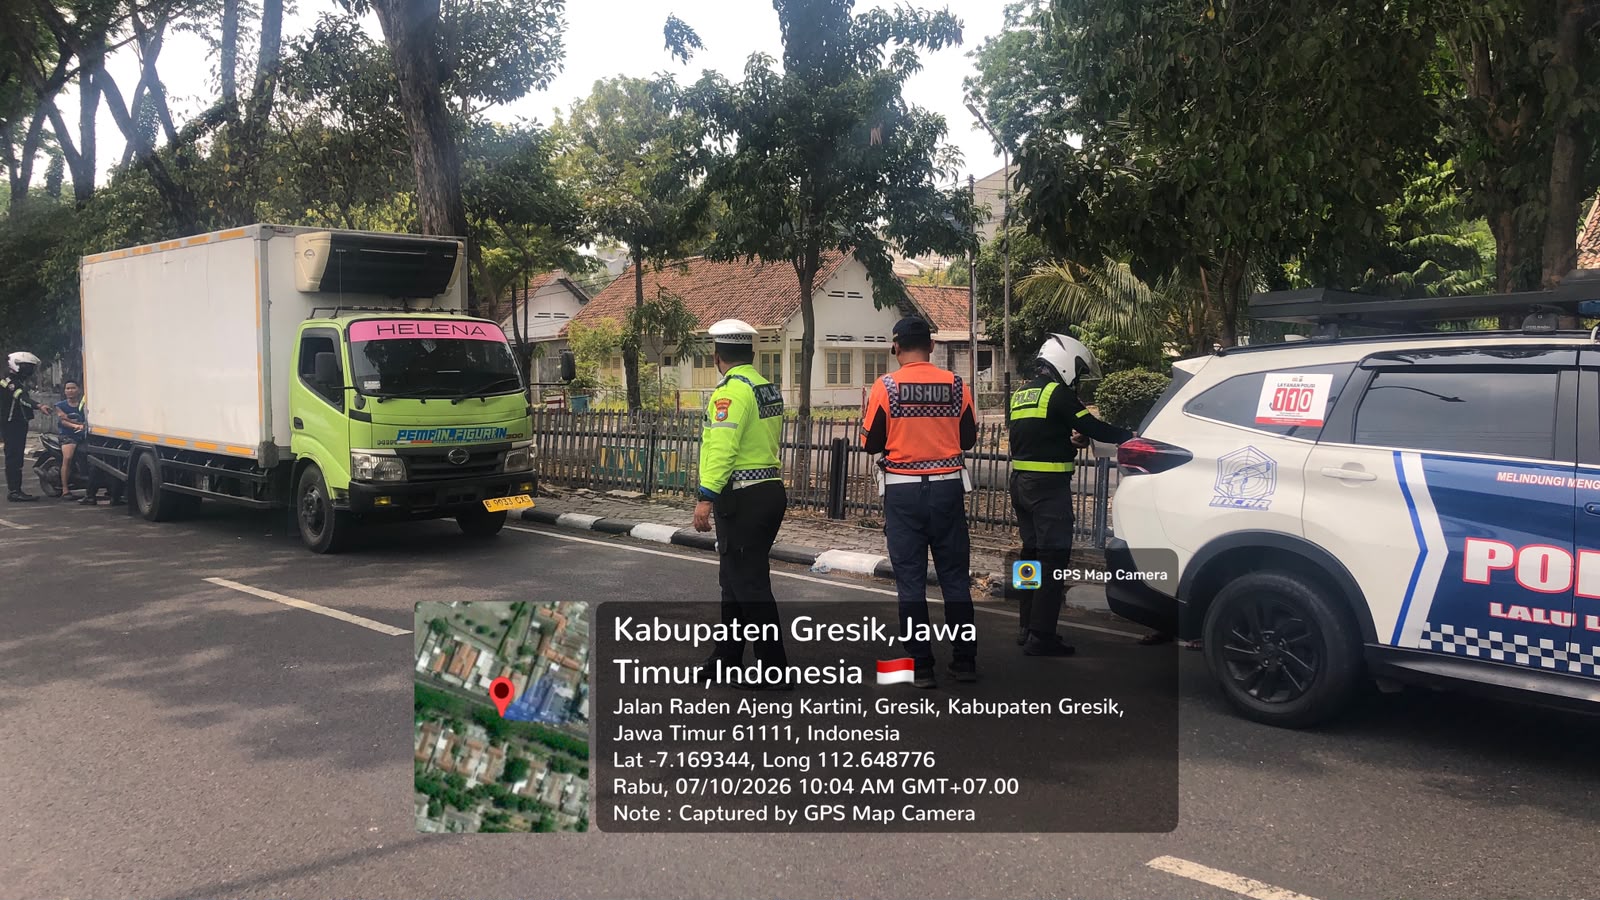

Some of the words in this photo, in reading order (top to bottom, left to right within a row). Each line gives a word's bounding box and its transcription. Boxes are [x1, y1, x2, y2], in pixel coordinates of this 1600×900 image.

[376, 323, 487, 336] HELENA
[900, 384, 950, 402] DISHUB
[1276, 389, 1312, 411] 110
[1497, 471, 1566, 487] MELINDUNGI
[484, 500, 492, 508] B
[1489, 602, 1577, 627] LALU
